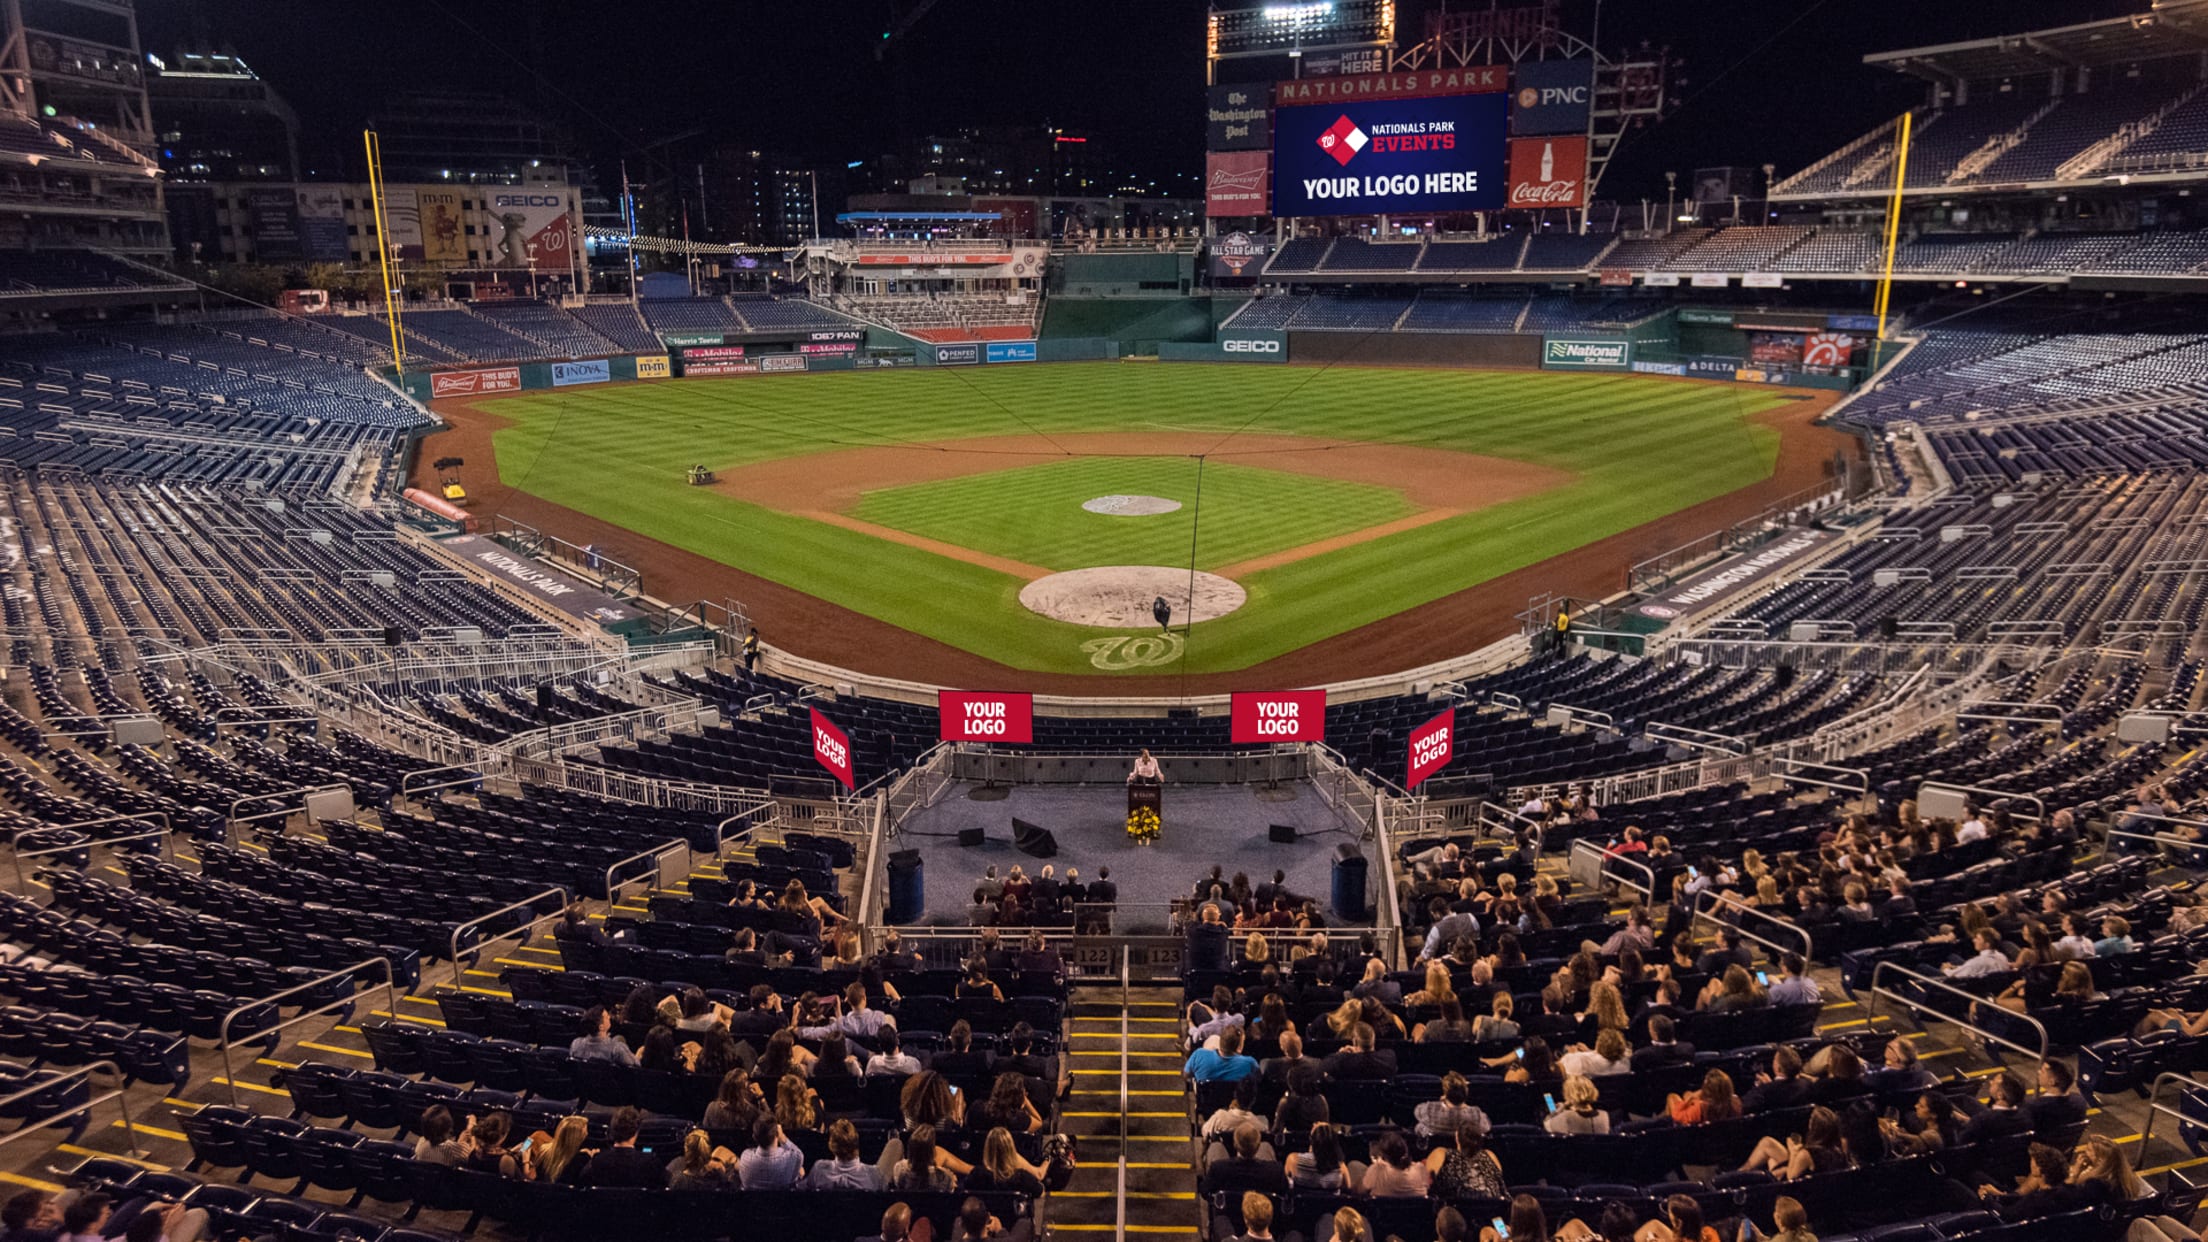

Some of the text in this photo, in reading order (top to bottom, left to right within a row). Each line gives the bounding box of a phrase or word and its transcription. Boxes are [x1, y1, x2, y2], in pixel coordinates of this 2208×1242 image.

[1341, 50, 1371, 61] HIT IT
[1341, 60, 1382, 74] HERE
[1283, 71, 1494, 98] NATIONALS PARK
[1228, 92, 1247, 106] The
[1541, 86, 1587, 105] PNC
[1209, 108, 1266, 122] Washington
[1225, 125, 1248, 140] Post
[1372, 121, 1455, 135] NATIONALS PARK
[1372, 134, 1455, 153] EVENTS
[1303, 171, 1478, 200] YOUR LOGO HERE
[496, 194, 560, 208] GEICO
[1210, 245, 1265, 257] ALL STAR GAME
[836, 332, 860, 340] FAN
[1223, 340, 1280, 353] GEICO
[1566, 344, 1623, 357] National
[566, 365, 601, 377] INOVA
[1700, 361, 1735, 372] DELTA
[498, 371, 518, 379] BUD'S
[482, 380, 496, 390] FOR
[475, 551, 576, 597] NATIONALS PARK
[1668, 537, 1814, 605] WASHINGTON NATIONALS
[963, 701, 1006, 717] YOUR
[1256, 701, 1299, 718] YOUR
[964, 719, 1006, 735] LOGO
[1257, 719, 1299, 735] LOGO
[816, 726, 846, 759] YOUR
[1413, 727, 1449, 755] YOUR
[816, 739, 846, 769] LOGO
[1413, 742, 1448, 770] LOGO
[1080, 950, 1181, 963] 122 123
